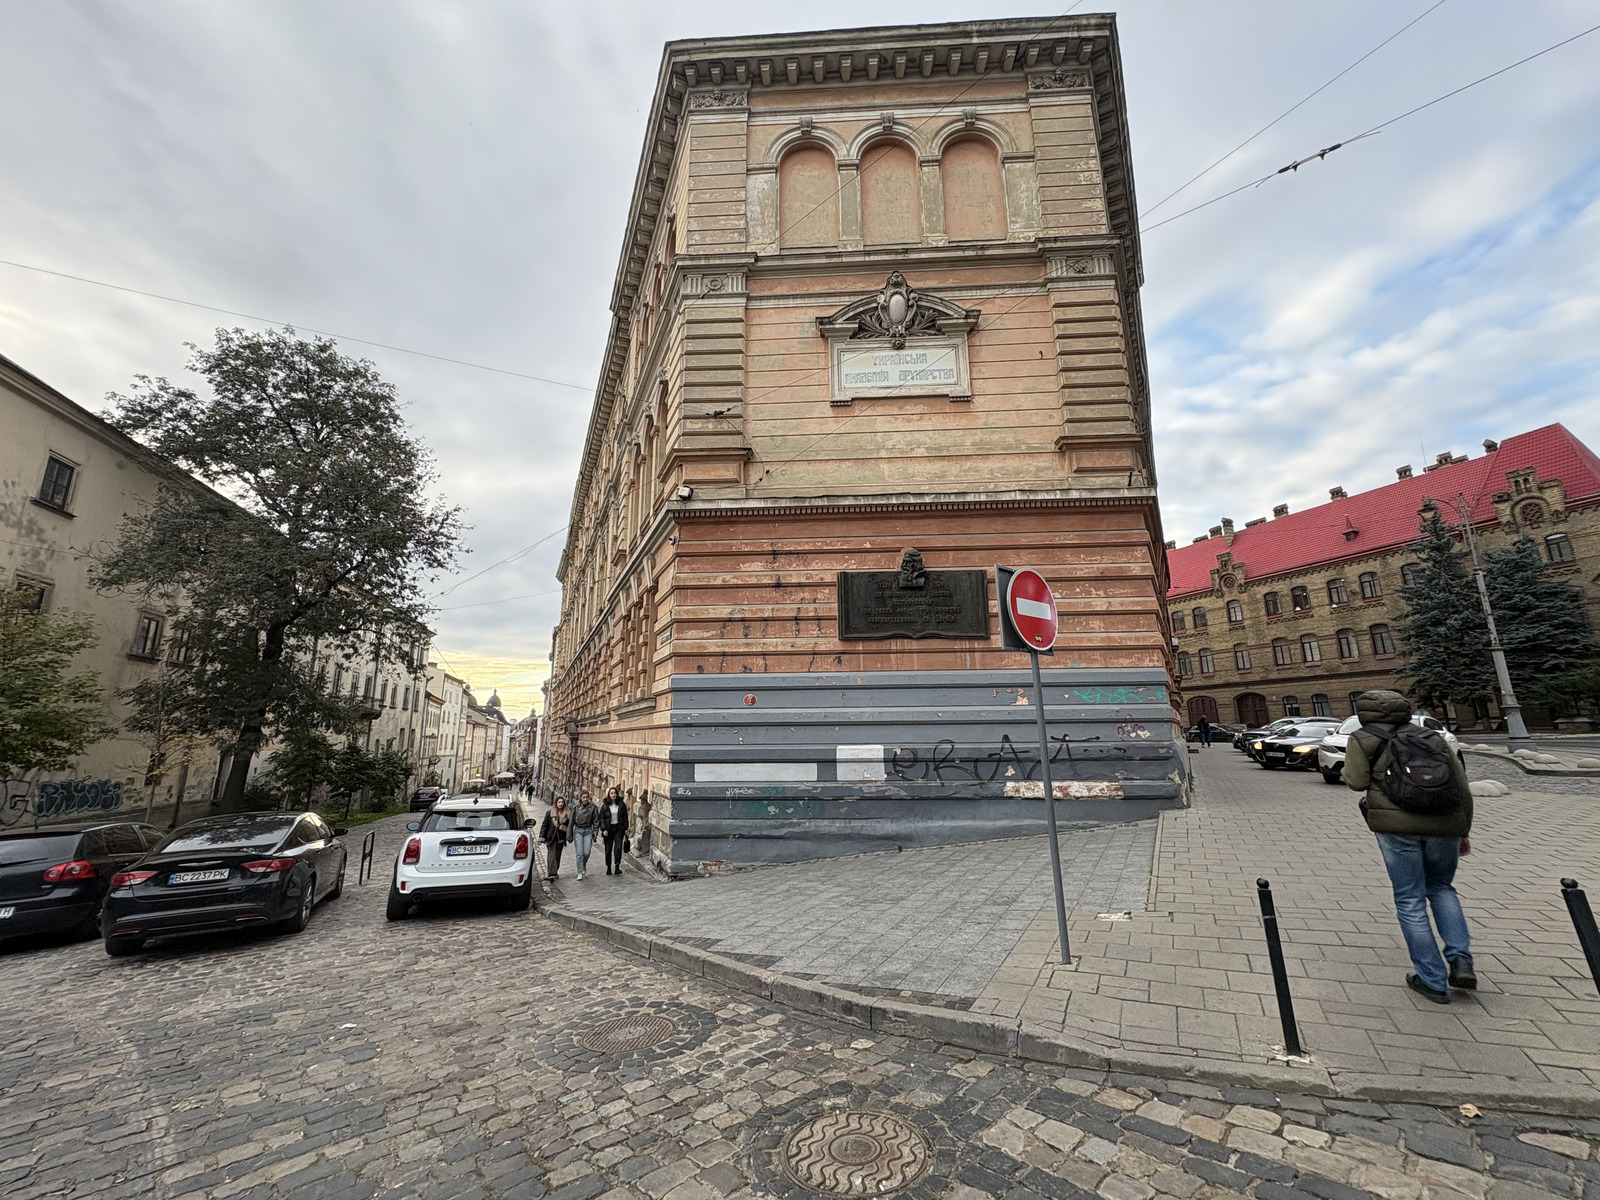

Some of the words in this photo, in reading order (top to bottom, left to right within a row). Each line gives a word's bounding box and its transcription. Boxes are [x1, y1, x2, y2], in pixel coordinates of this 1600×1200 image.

[872, 353, 928, 366] УКРАЇНСЬКА
[175, 873, 189, 883] BC
[190, 870, 212, 881] 2237
[212, 869, 227, 880] PK
